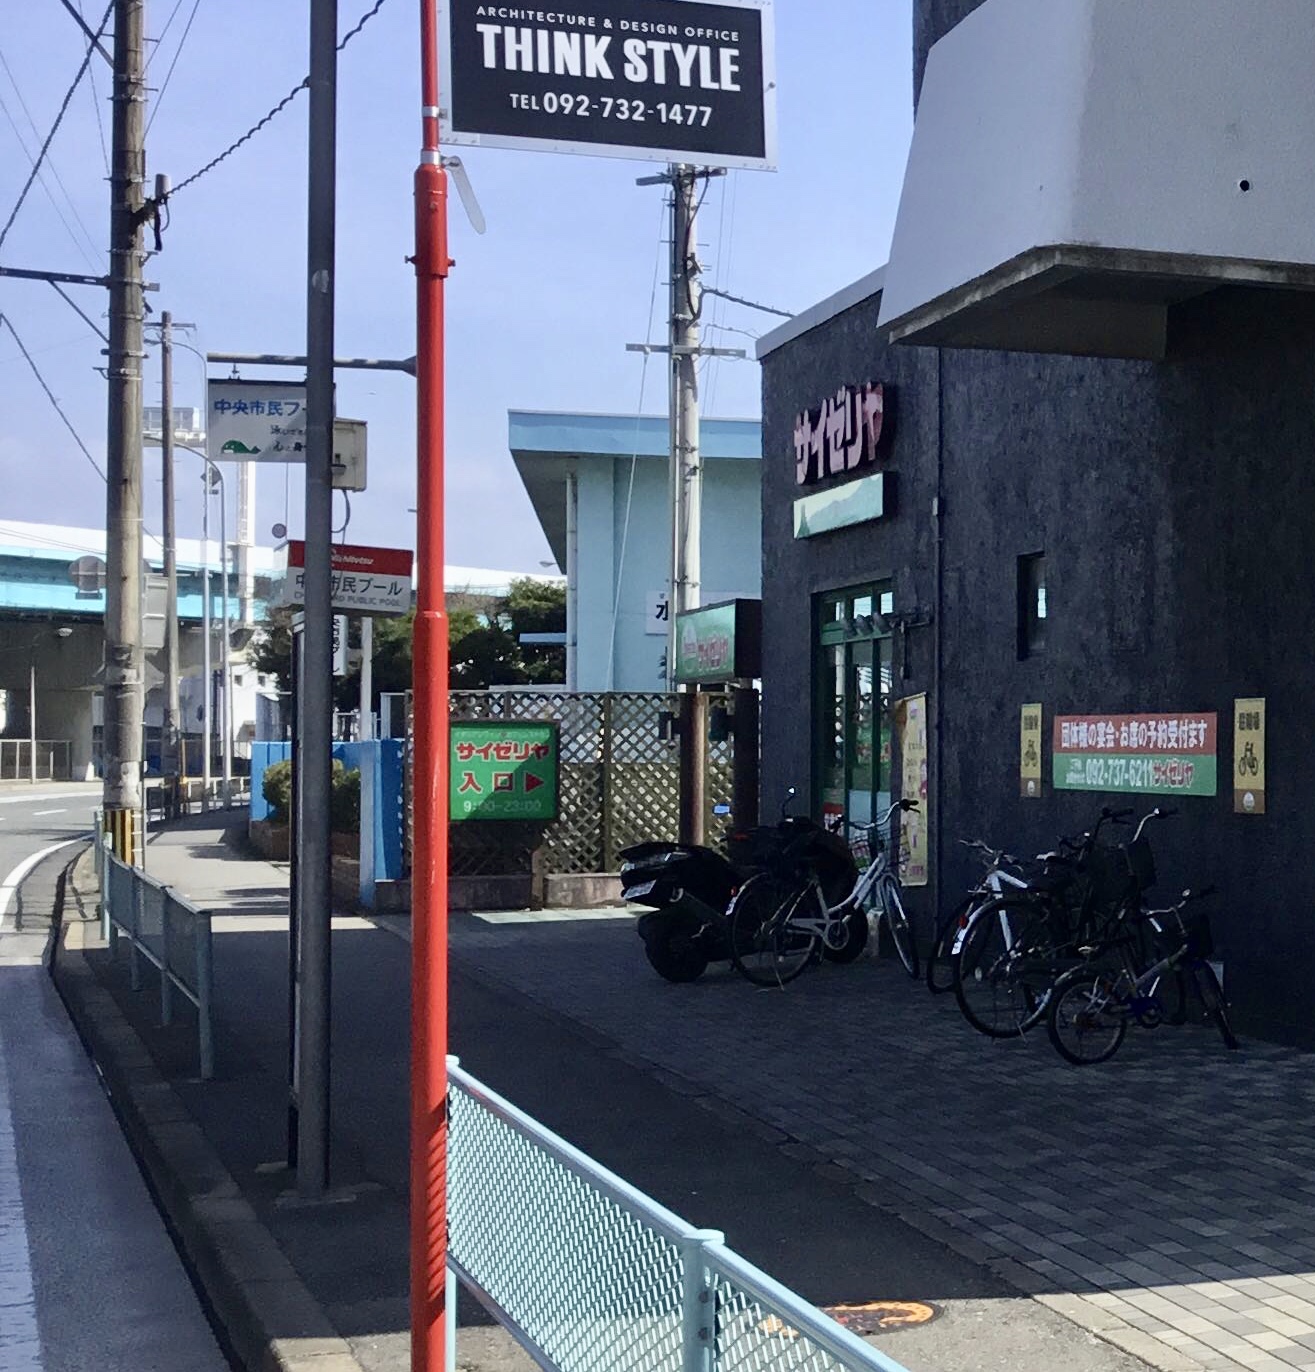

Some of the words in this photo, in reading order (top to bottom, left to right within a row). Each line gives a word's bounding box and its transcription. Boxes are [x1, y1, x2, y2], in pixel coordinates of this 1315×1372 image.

[476, 6, 596, 28] ARCHITECTURE
[603, 18, 613, 29] &
[620, 20, 678, 36] DESIGN
[685, 26, 740, 42] OFFICE
[476, 23, 615, 80] THINK
[623, 38, 741, 92] STYLE
[510, 93, 540, 111] TEL
[543, 92, 712, 127] 092-732-1477
[794, 381, 884, 485] サイゼリヤ
[296, 573, 402, 596] 中市民プール
[456, 741, 551, 761] サイゼリヤ
[457, 771, 514, 794] 入口
